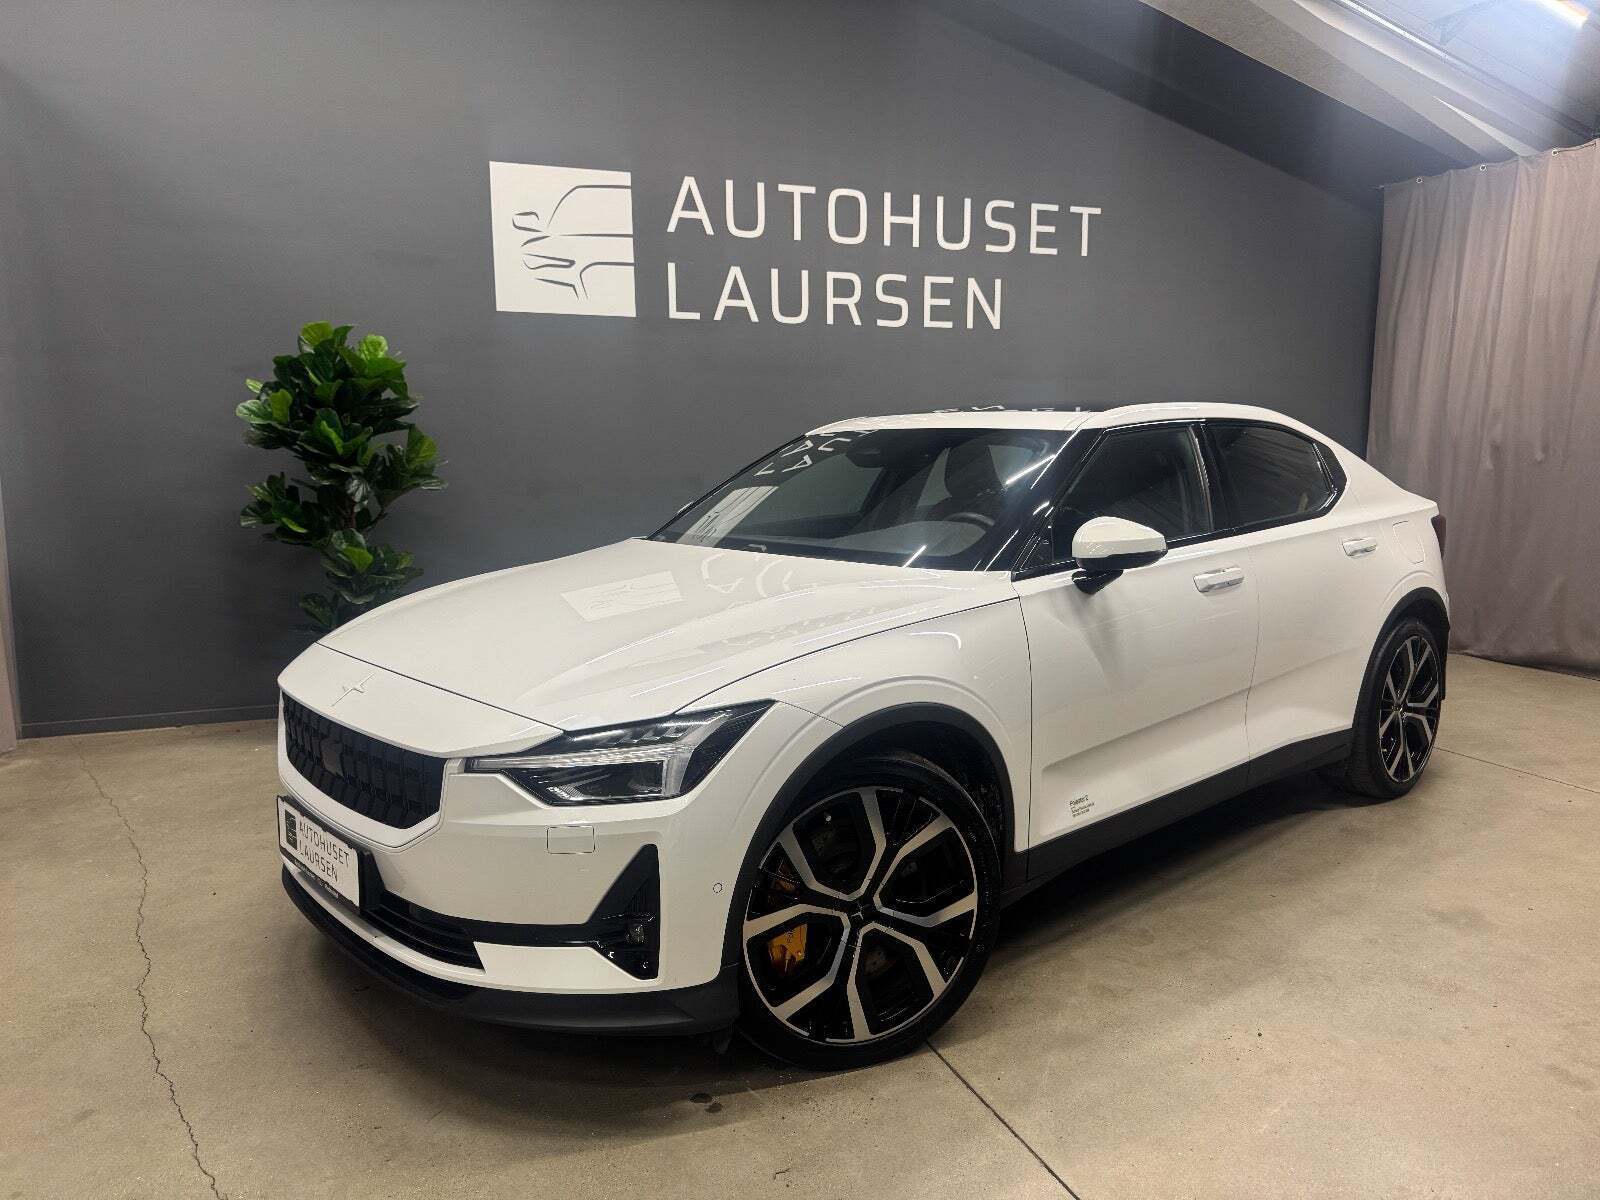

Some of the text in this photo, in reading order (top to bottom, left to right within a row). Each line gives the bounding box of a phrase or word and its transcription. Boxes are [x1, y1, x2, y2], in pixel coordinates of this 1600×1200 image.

[667, 176, 1102, 257] AUTOHUSET
[667, 261, 1002, 330] LAURSEN
[299, 820, 349, 868] AUTOHUSET
[299, 840, 338, 881] LAURSEN
